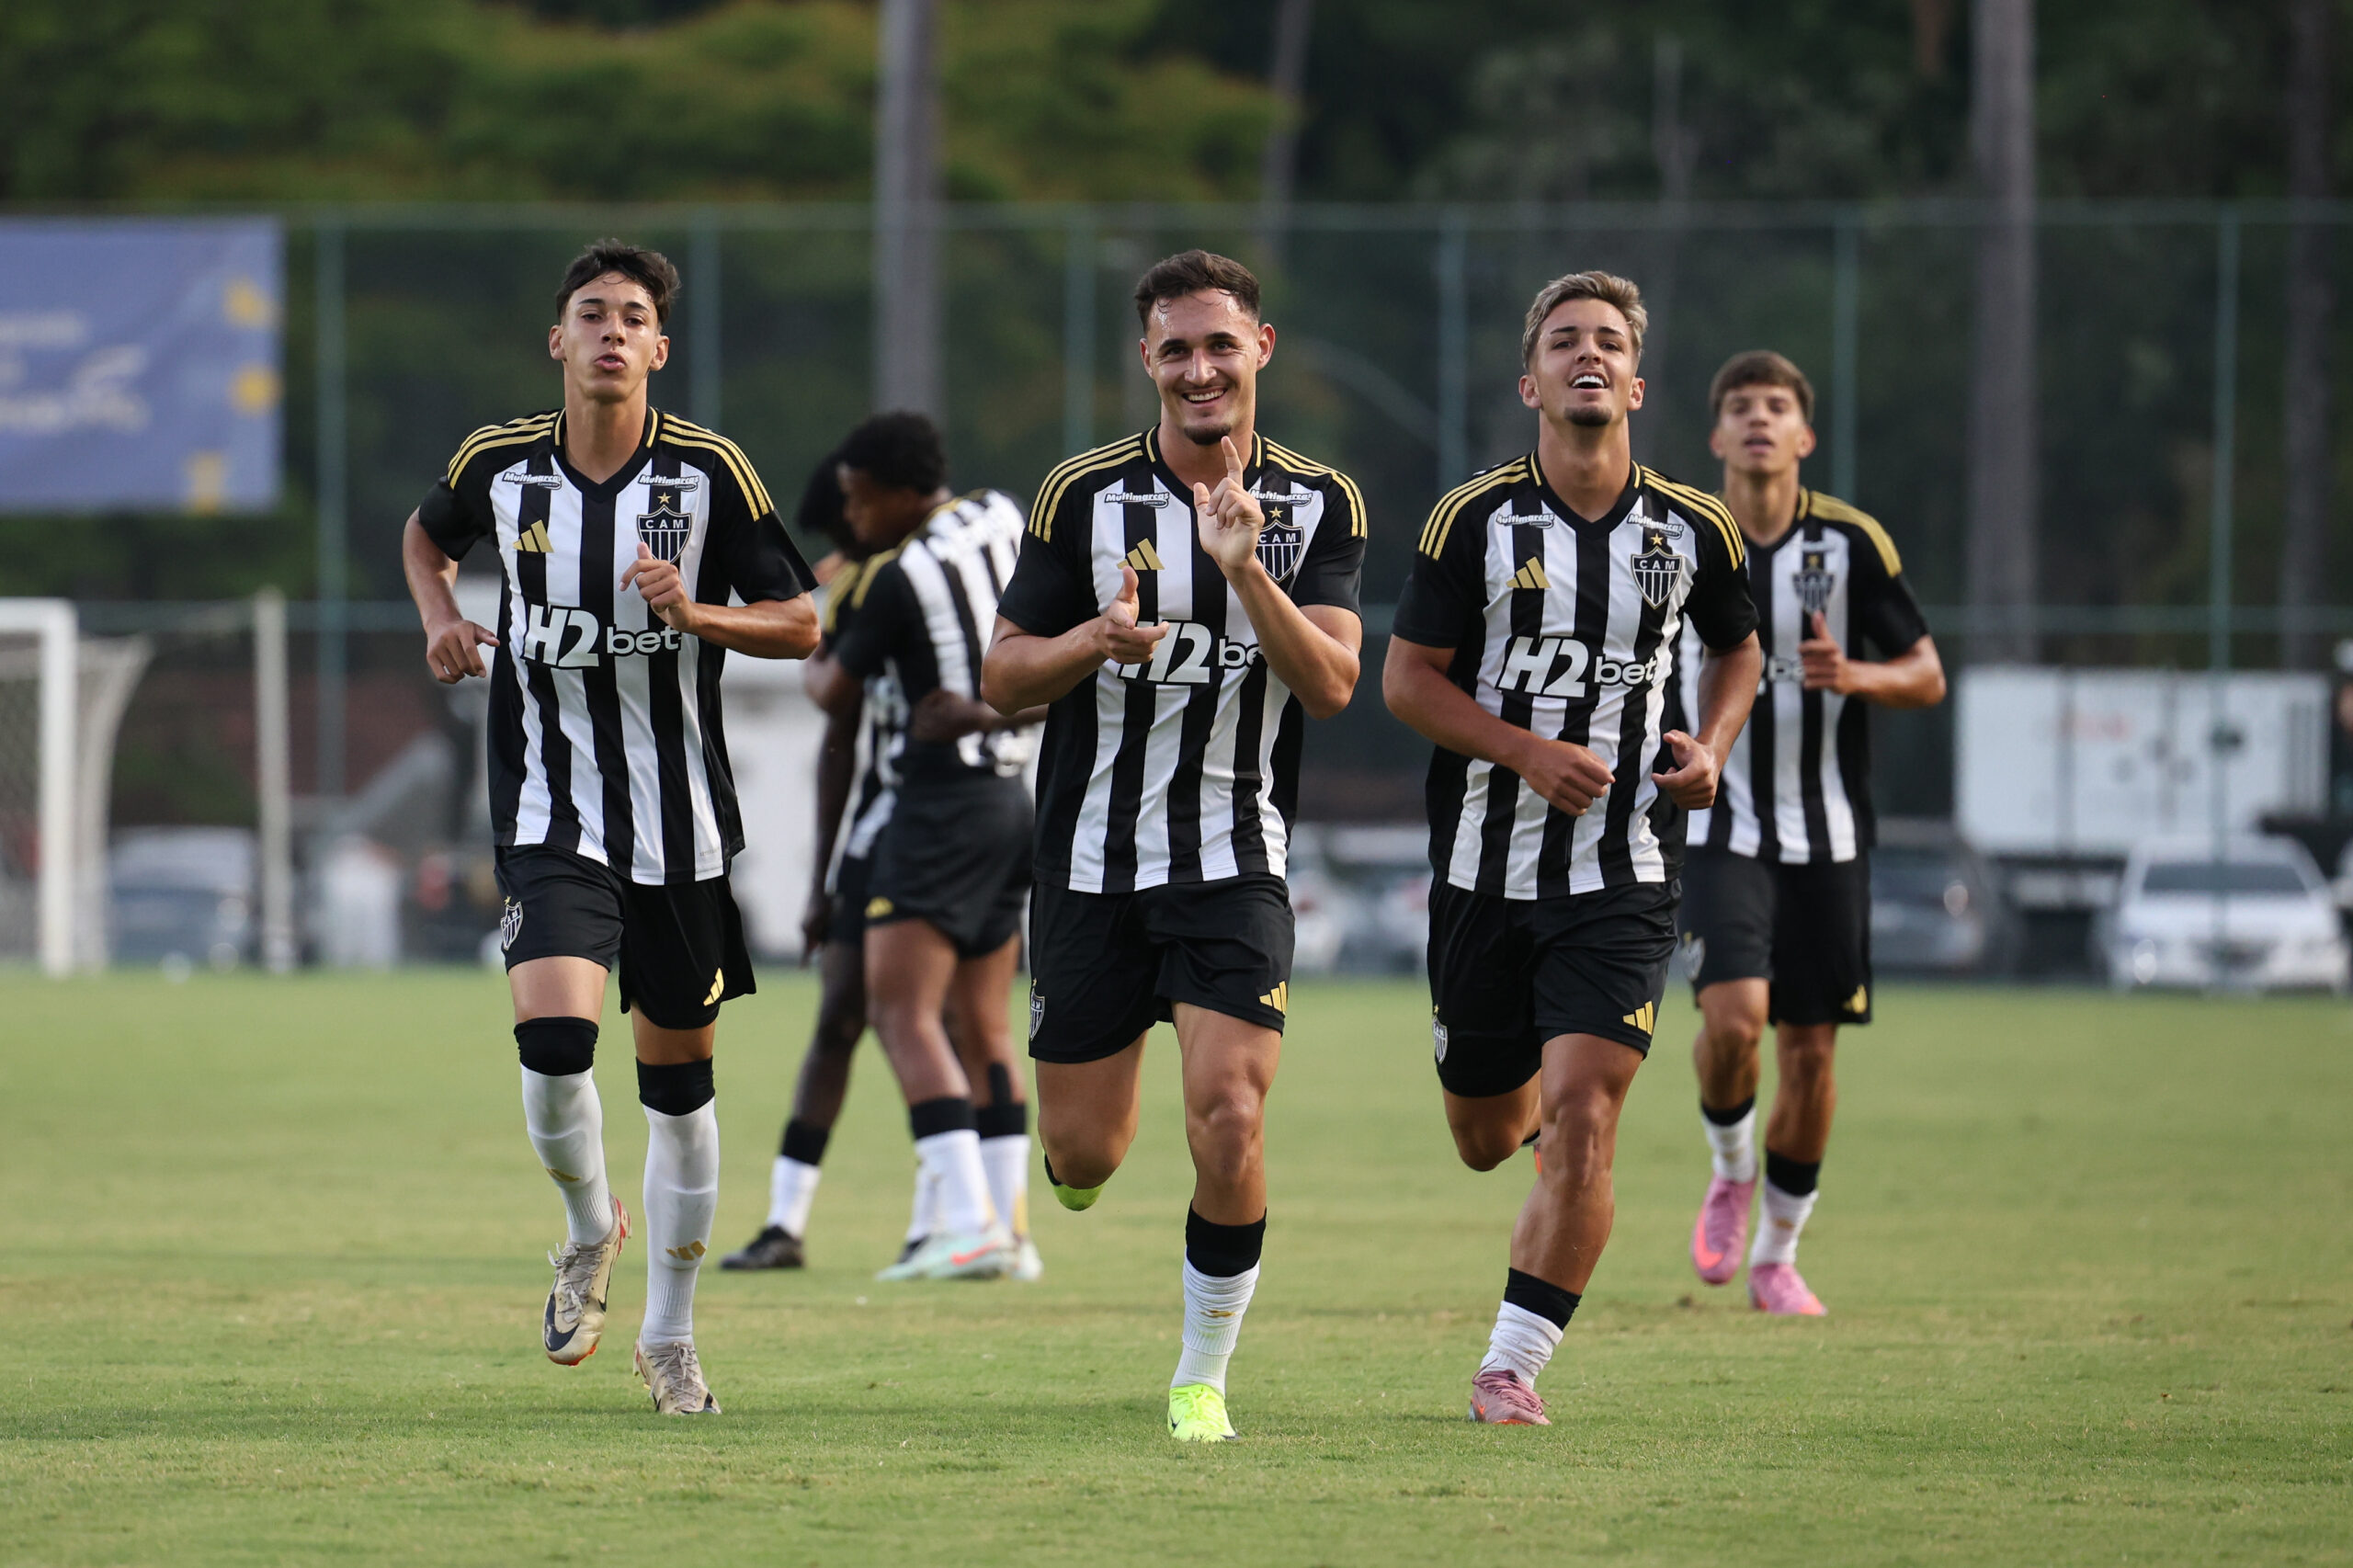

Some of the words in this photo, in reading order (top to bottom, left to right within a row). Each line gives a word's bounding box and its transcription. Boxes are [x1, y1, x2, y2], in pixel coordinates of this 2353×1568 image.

[639, 474, 699, 485] Multimarcas
[1106, 492, 1170, 502] Multimarcas
[645, 518, 684, 529] CAM
[1258, 532, 1297, 544] CAM
[1639, 559, 1676, 571] CAM
